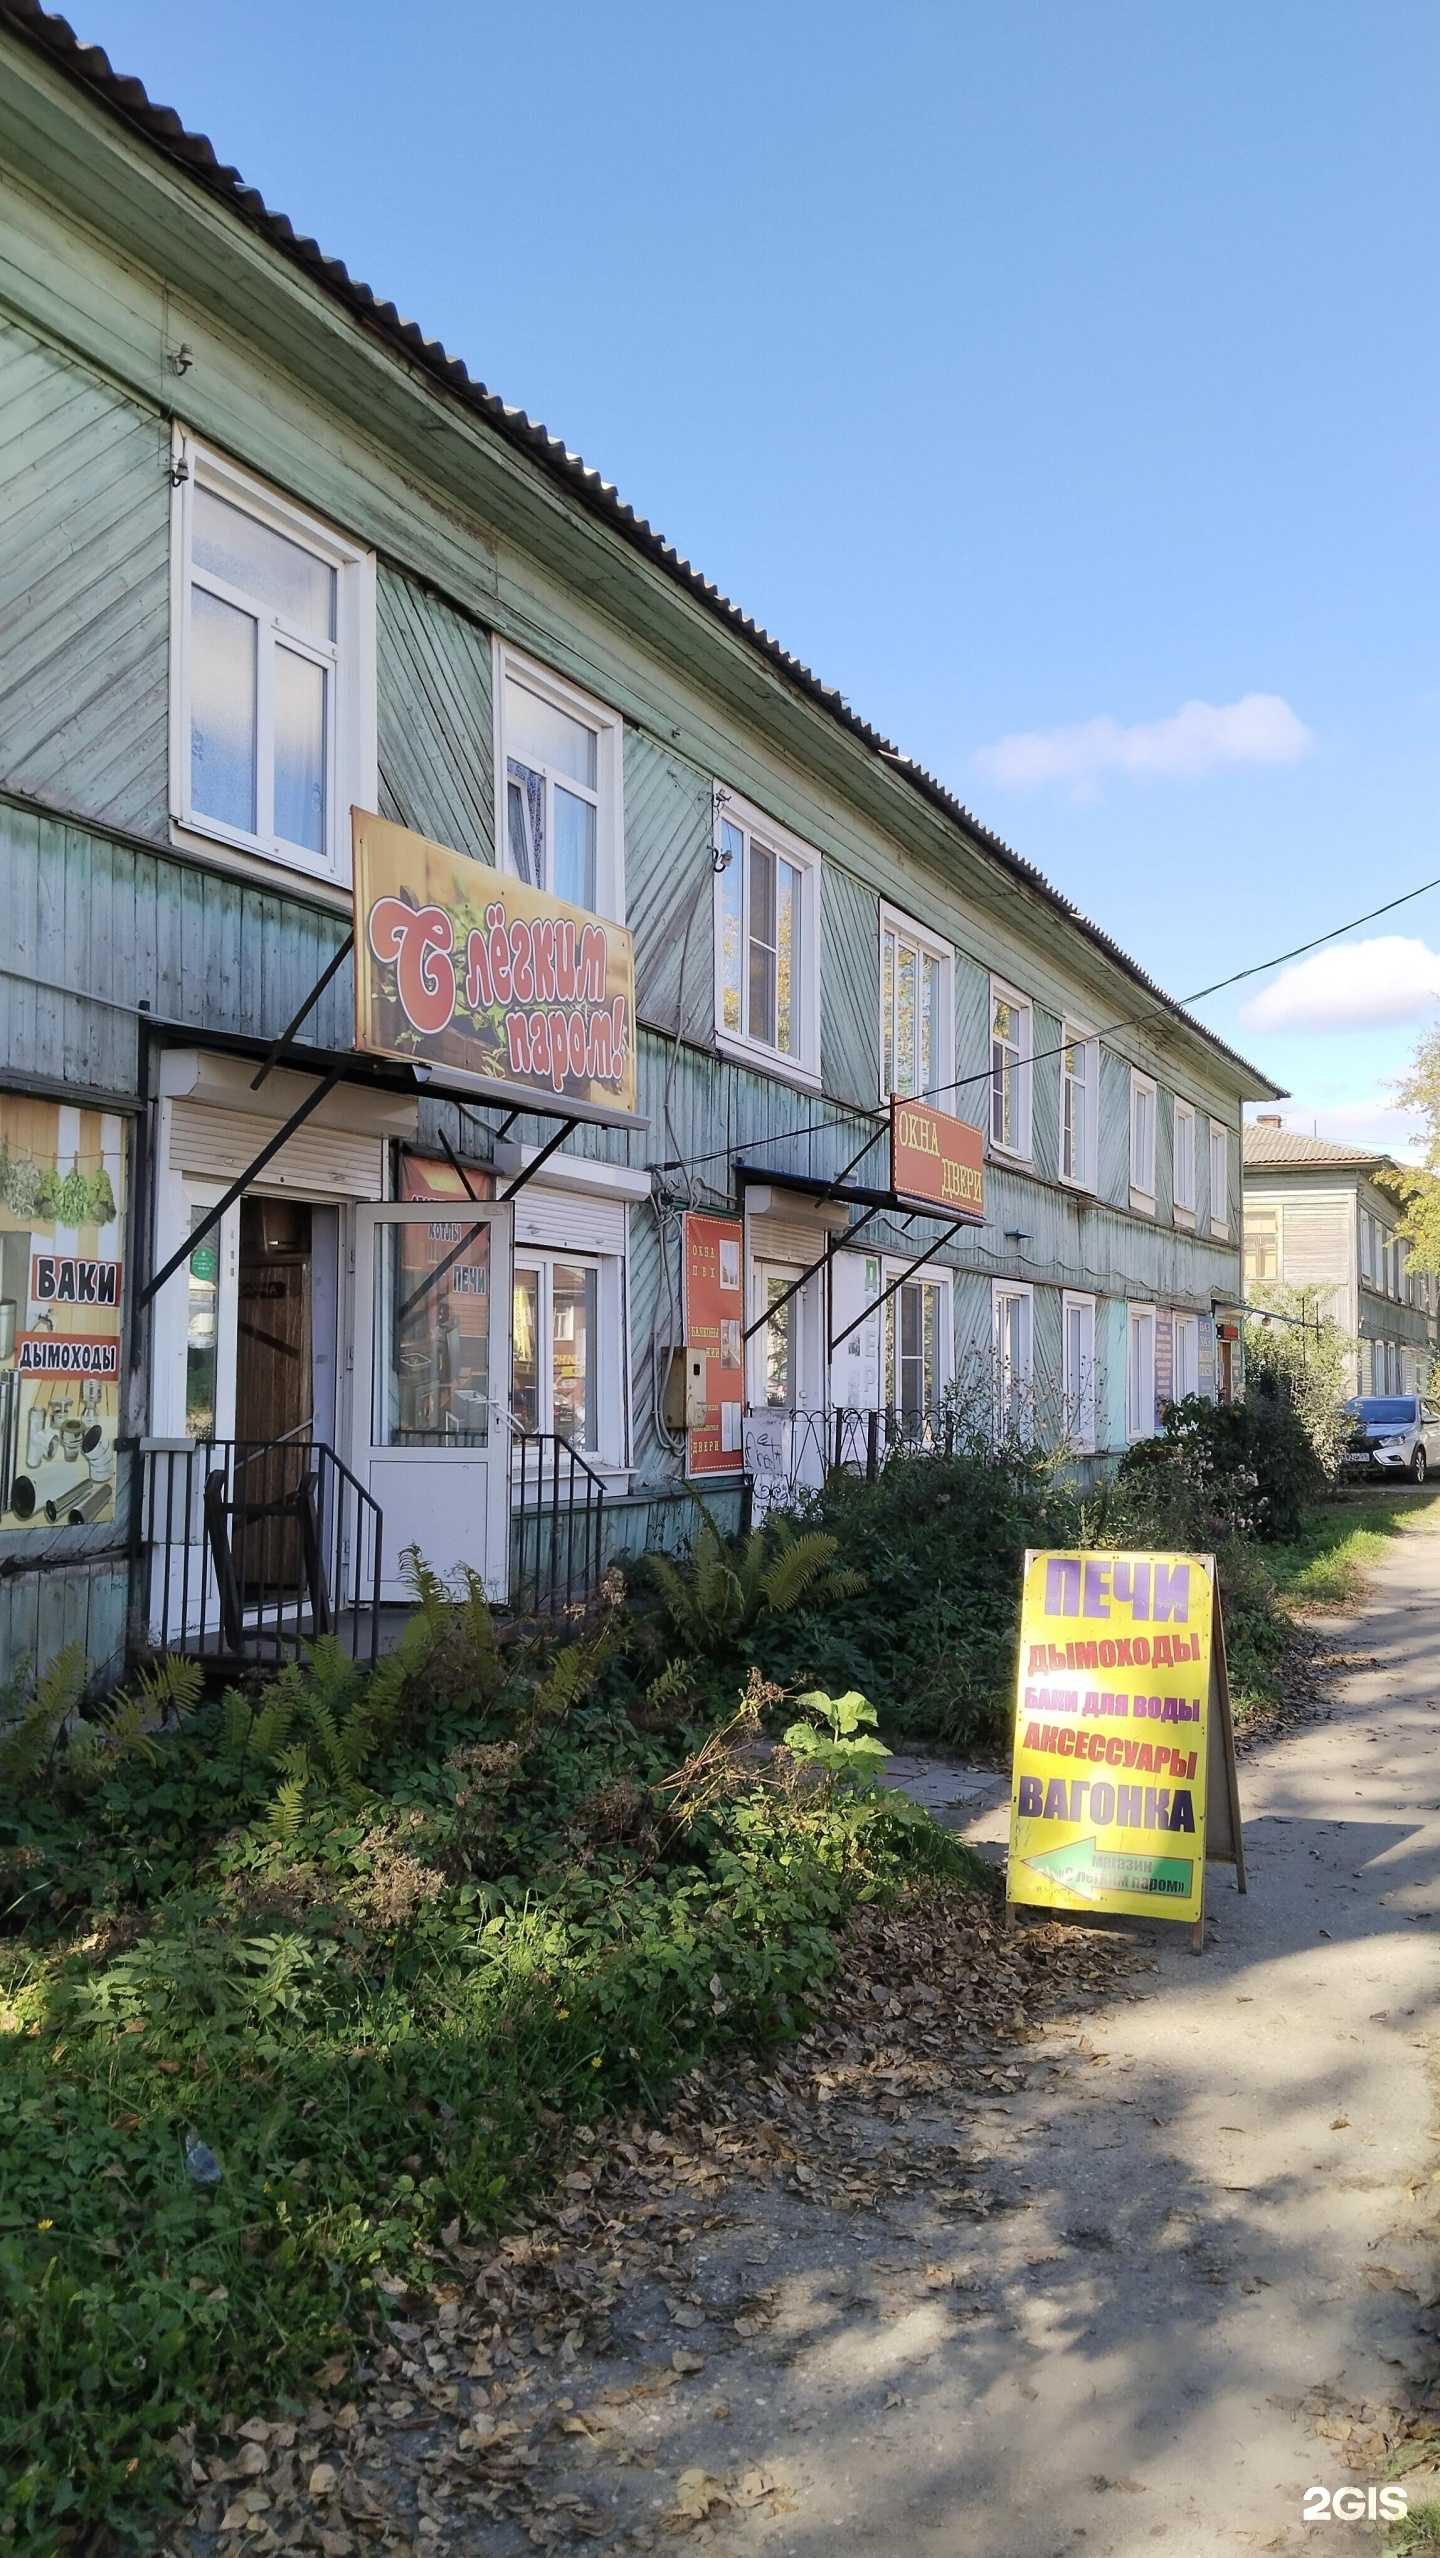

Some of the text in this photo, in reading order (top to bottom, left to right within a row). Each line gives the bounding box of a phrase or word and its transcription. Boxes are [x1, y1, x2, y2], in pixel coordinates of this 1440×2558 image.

[370, 897, 608, 1034] С лёгким
[506, 996, 625, 1092] паром!
[899, 1110, 940, 1157] ОКНА
[942, 1158, 982, 1203] ДВЕРИ
[37, 1256, 117, 1306] БАКИ
[453, 1263, 487, 1296] ПЕЧИ
[19, 1341, 117, 1374] ДЫМОХОДЫ
[692, 1440, 719, 1455] ДВЕРИ
[1044, 1558, 1190, 1623] ПЕЧИ
[1027, 1632, 1201, 1677] ДЫМОХОДЫ
[1024, 1686, 1201, 1724] БАКИ ДЛЯ ВОДЫ
[1023, 1721, 1199, 1780] АКСЕССУАРЫ
[1018, 1775, 1196, 1833] ВАГОНКА
